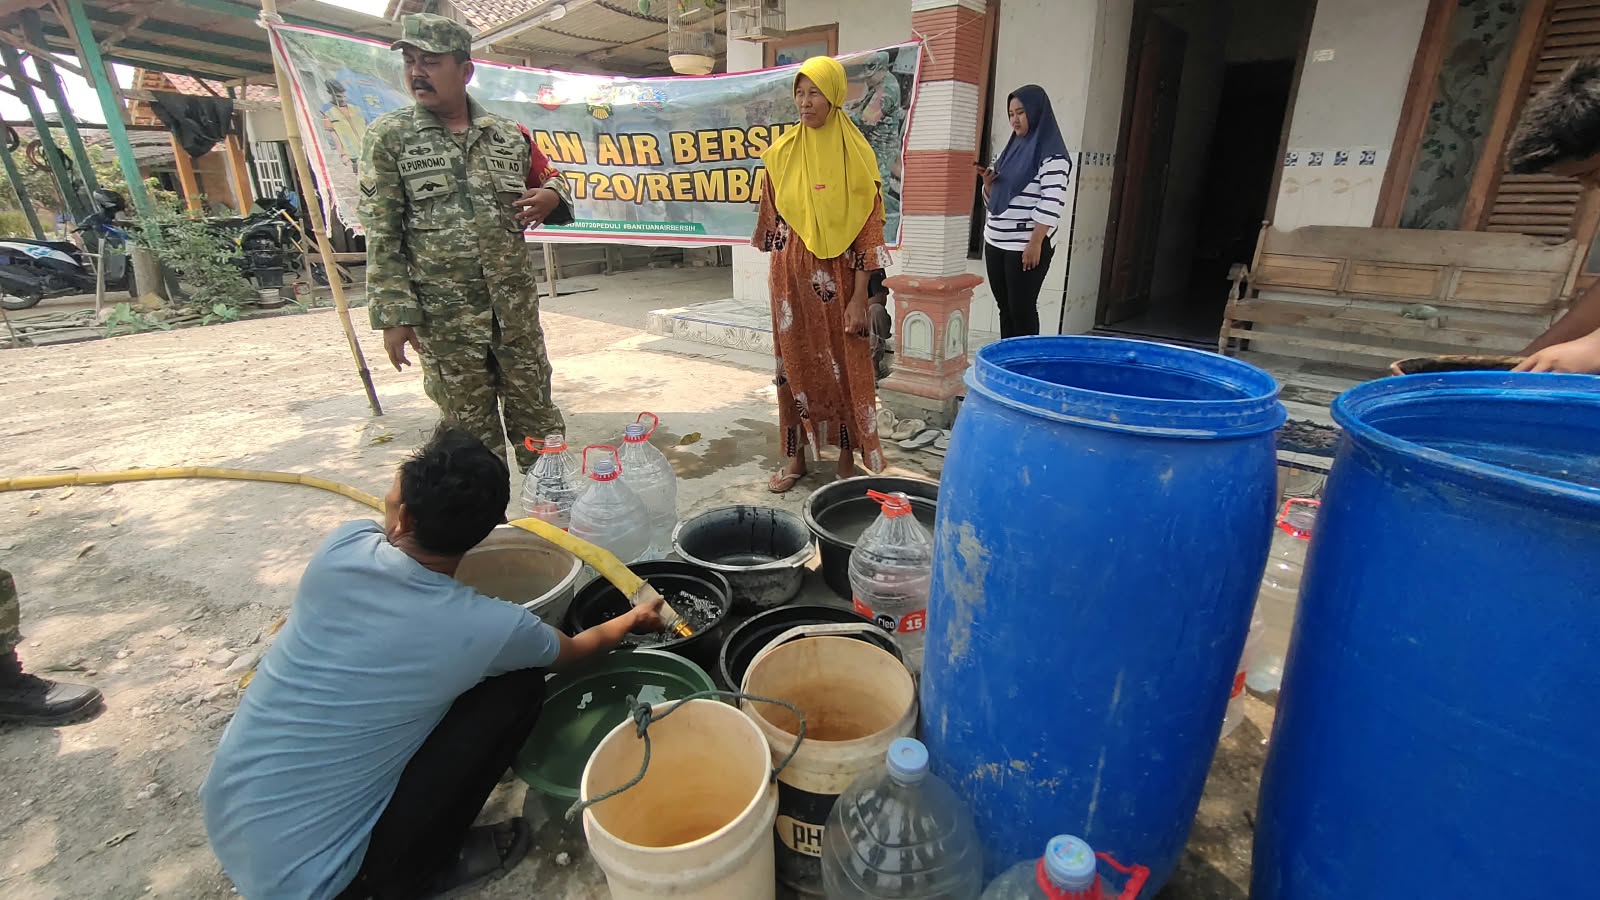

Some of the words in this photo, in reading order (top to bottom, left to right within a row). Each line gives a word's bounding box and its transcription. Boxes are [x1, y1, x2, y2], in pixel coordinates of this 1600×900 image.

[596, 132, 663, 166] AIR
[669, 121, 800, 164] BERSI
[400, 157, 446, 173] H.PURNOMO
[490, 159, 505, 169] TNI
[508, 161, 520, 172] AD
[559, 166, 763, 204] 720/REMBA
[623, 223, 696, 232] #BANTUANAIRBERSIH
[906, 618, 923, 631] 15
